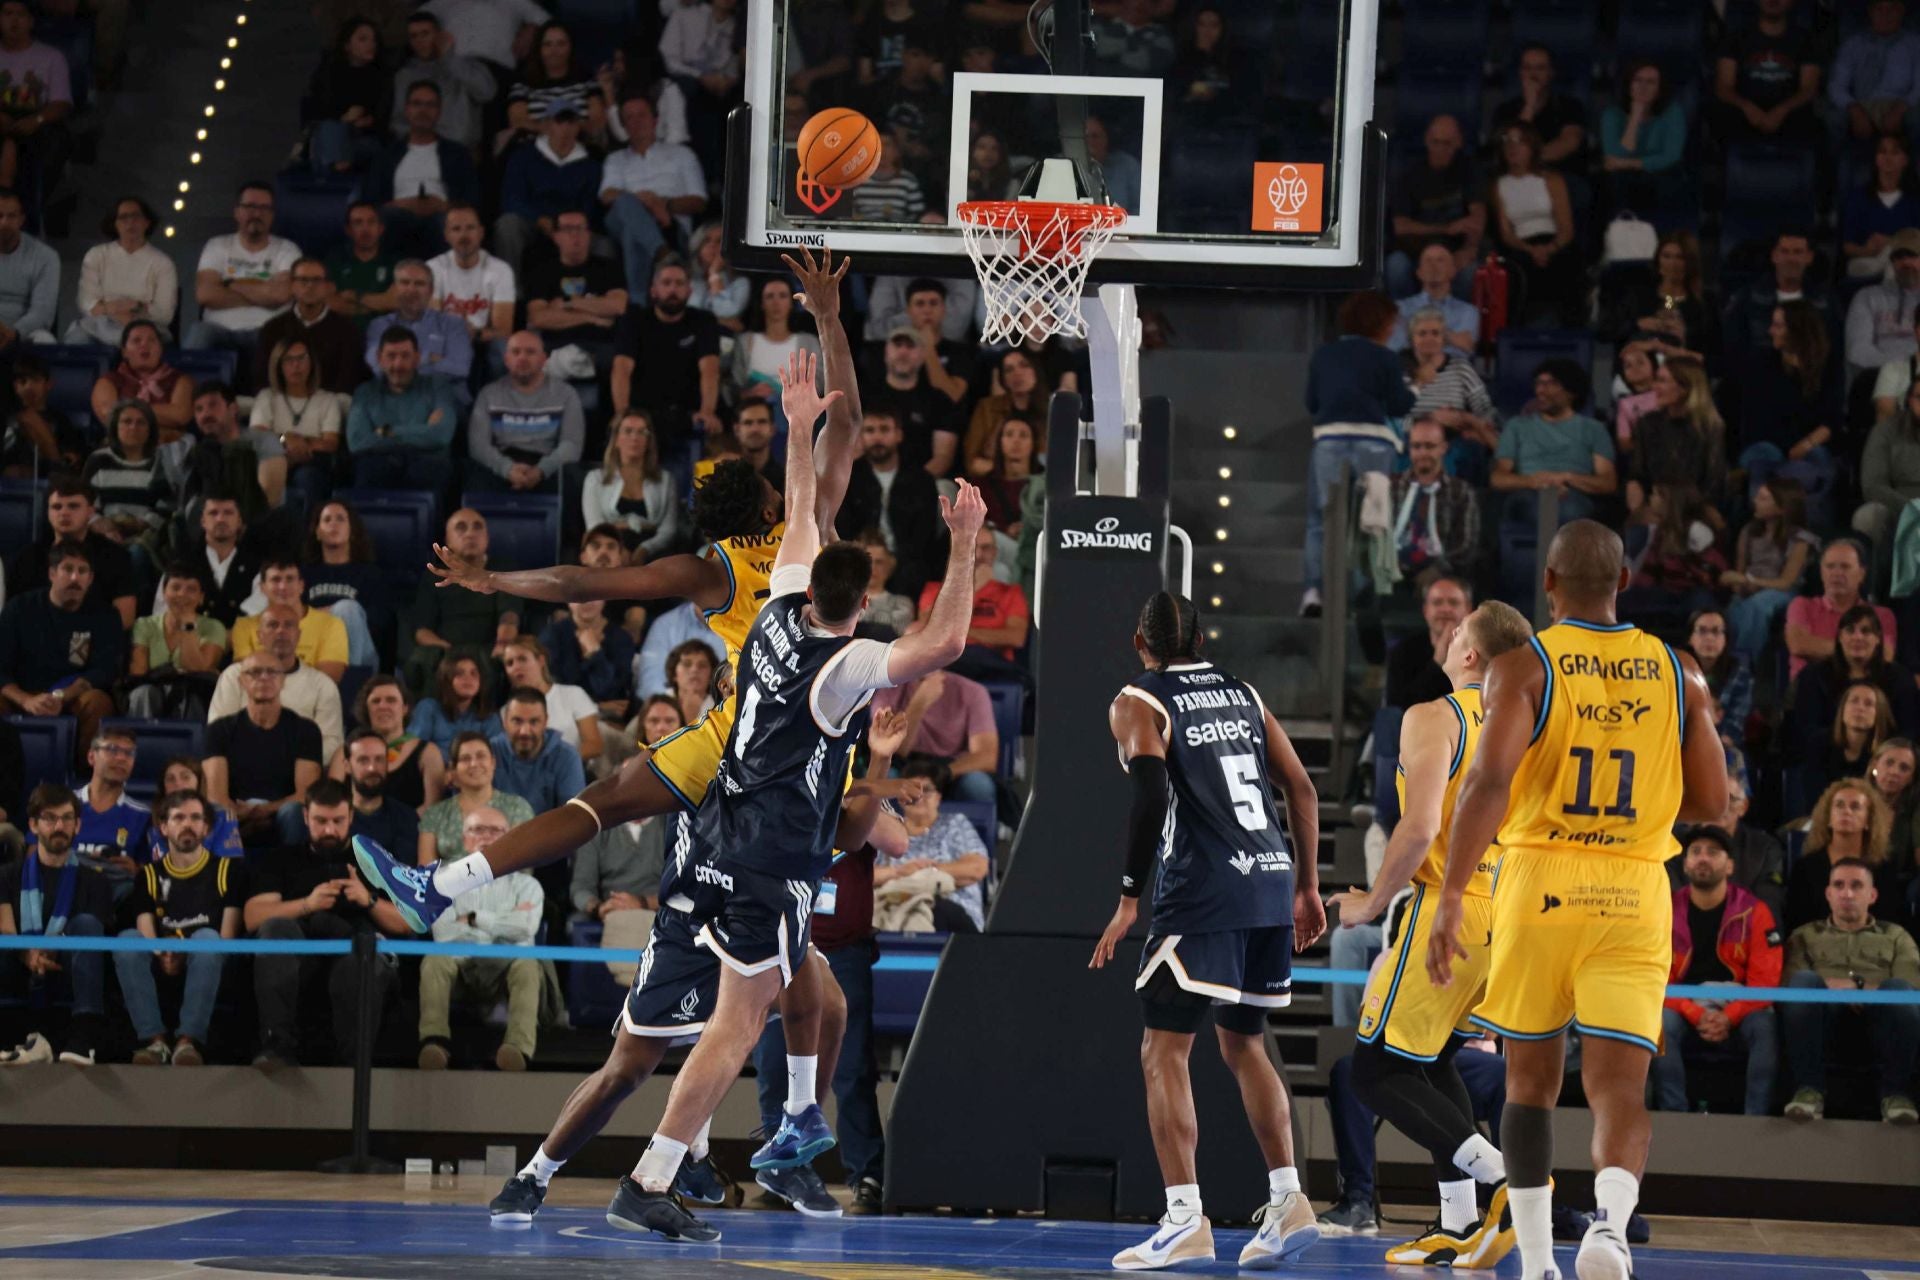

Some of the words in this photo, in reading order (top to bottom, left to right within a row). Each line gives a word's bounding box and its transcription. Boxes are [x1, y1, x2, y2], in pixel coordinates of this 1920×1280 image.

[1273, 221, 1300, 231] FEB
[766, 232, 824, 247] SPALDING
[730, 535, 783, 549] NWO
[1060, 529, 1152, 552] SPALDING
[785, 651, 800, 674] A.
[1559, 654, 1661, 681] GRANGER
[1172, 690, 1231, 713] PARHAM
[1576, 704, 1622, 723] MGS
[1219, 753, 1268, 831] 5
[1562, 746, 1637, 819] 11
